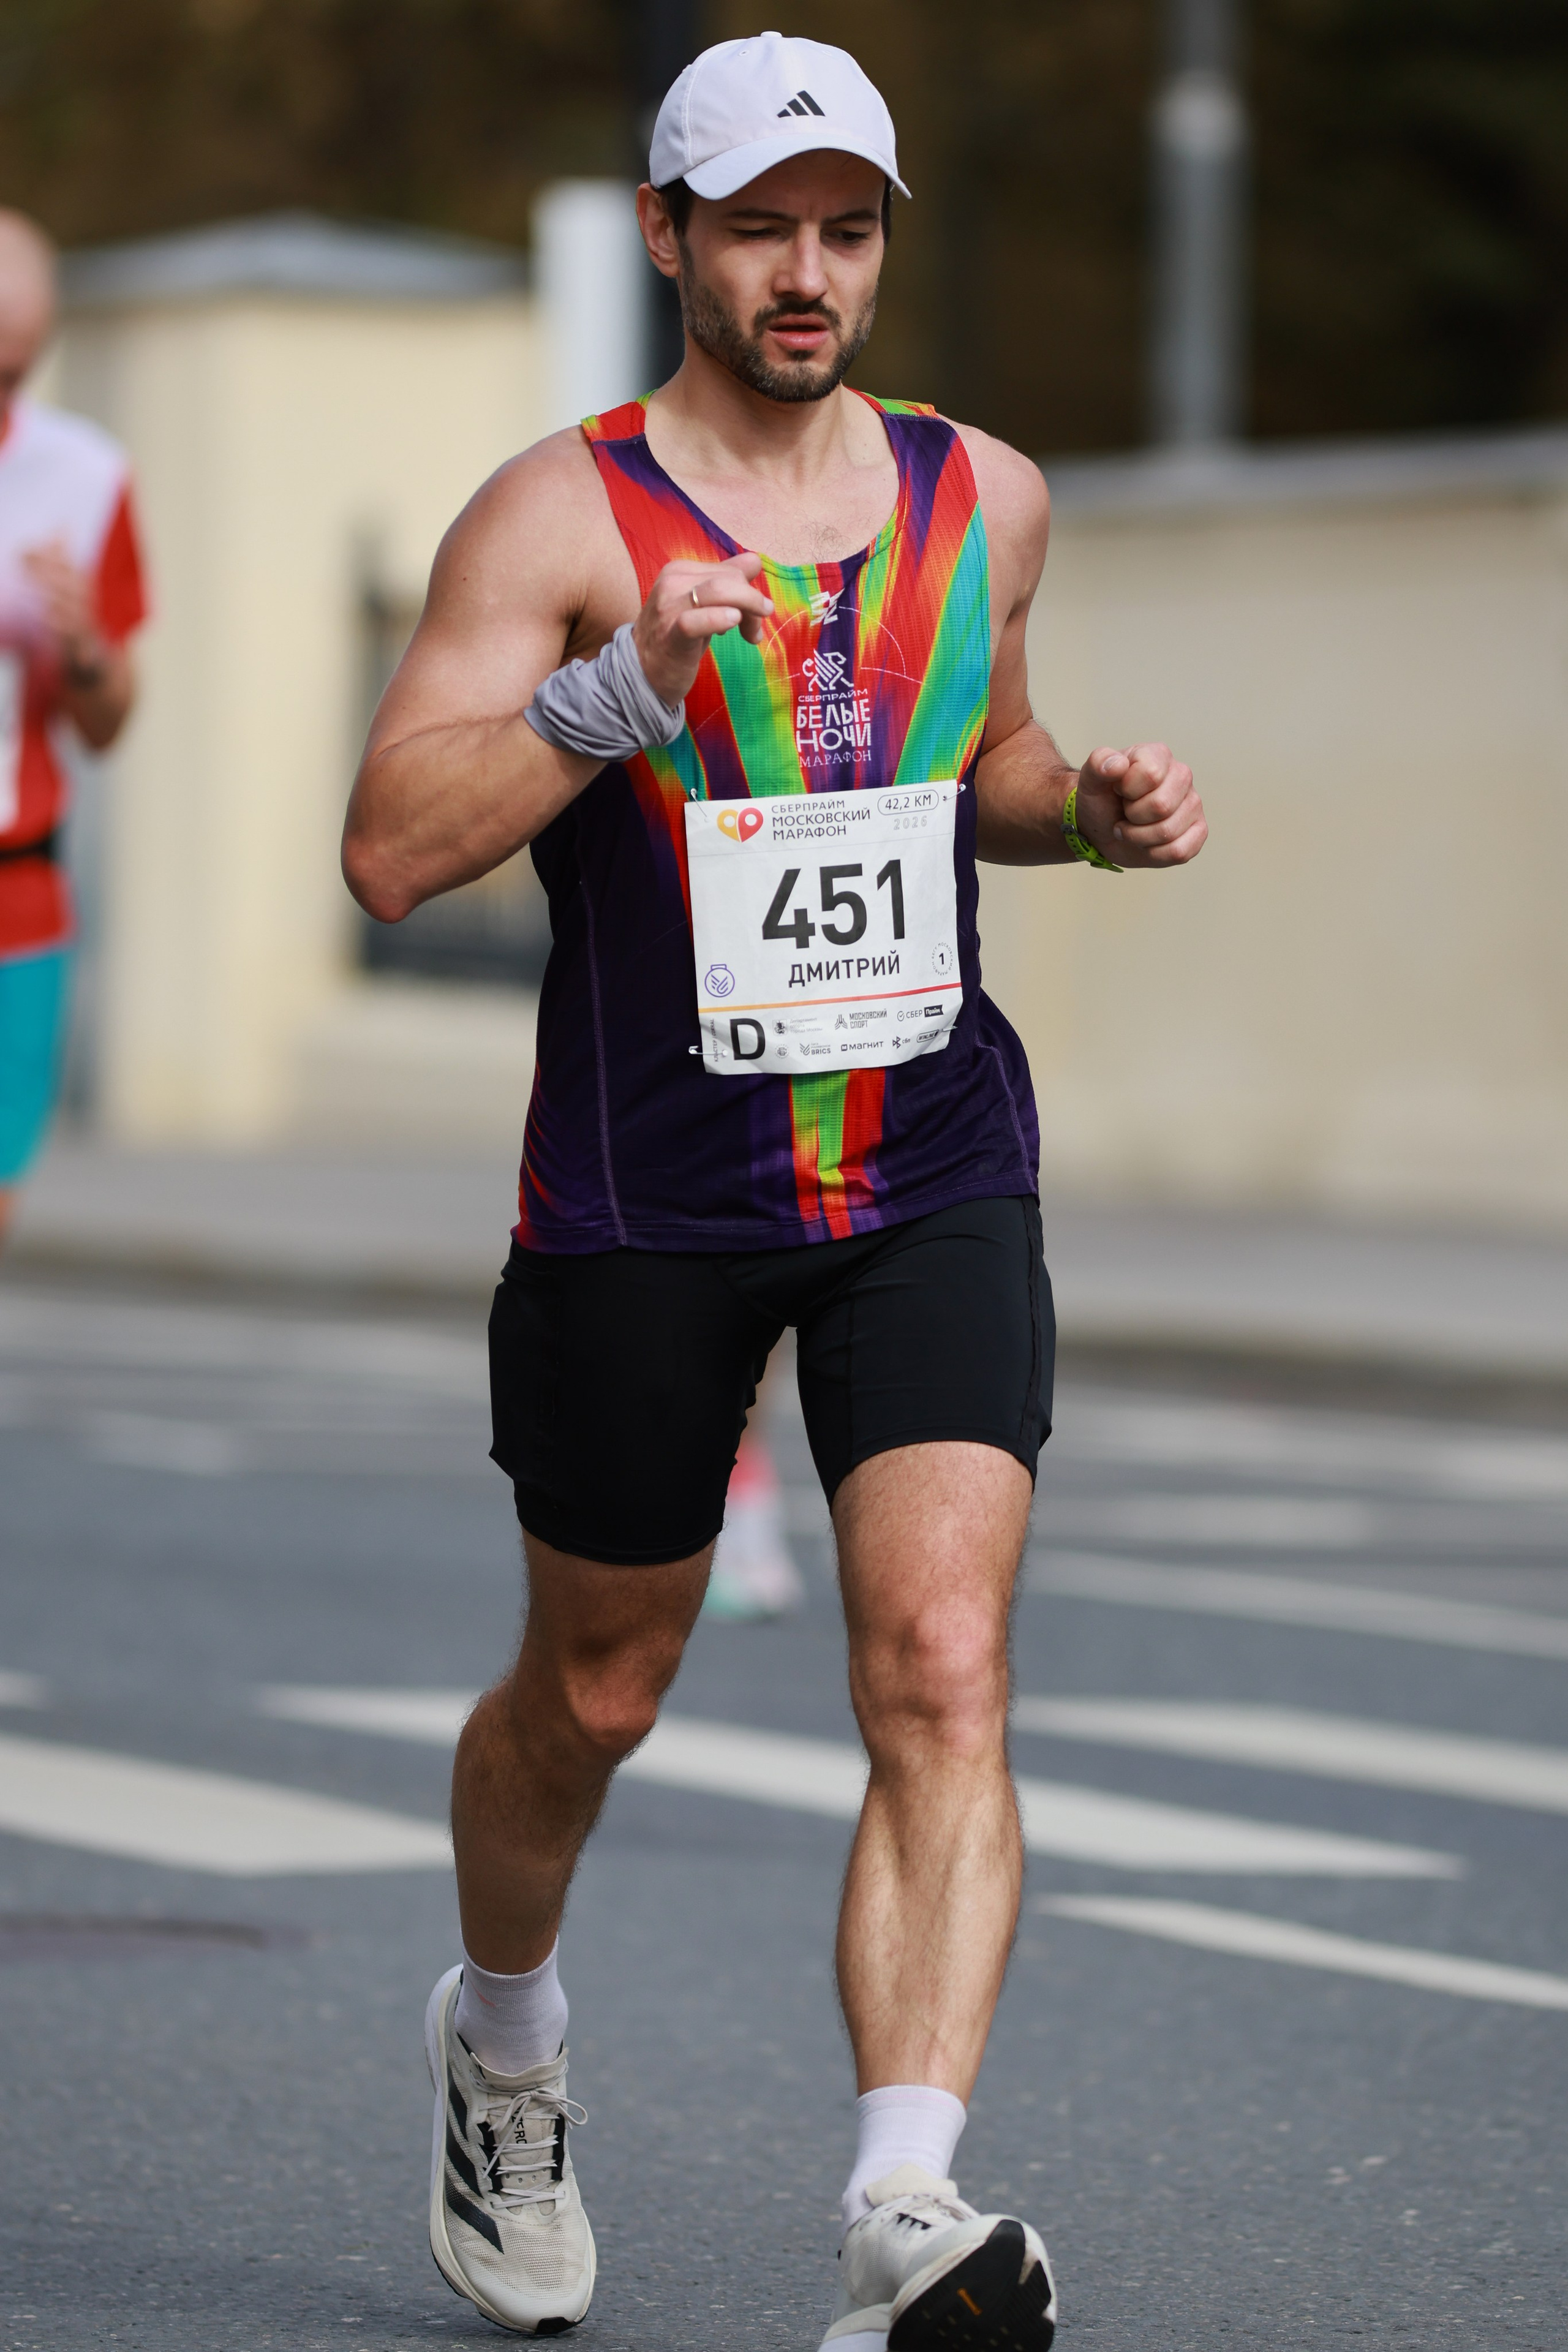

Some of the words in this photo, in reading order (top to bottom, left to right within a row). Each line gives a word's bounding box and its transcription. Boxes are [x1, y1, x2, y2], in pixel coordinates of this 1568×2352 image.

[798, 688, 868, 703] СБЕРПРАЙМ
[796, 698, 871, 729] БЕЛЫЕ
[796, 723, 871, 753] НОЧИ
[799, 750, 871, 768] МАРАФОН
[771, 799, 845, 813] СБЕРПРАЙМ
[885, 797, 910, 810] 42,2
[914, 794, 931, 807] КМ
[772, 807, 870, 827] МОСКОВСКИЙ
[893, 815, 927, 831] 2026
[773, 825, 846, 840] МАРАФОН
[761, 859, 905, 949] 451
[939, 952, 944, 965] 1
[788, 950, 900, 988] ДМИТРИЙ
[849, 1008, 887, 1020] МОСКОВСКИЙ
[906, 1009, 923, 1019] СБЕР
[850, 1020, 868, 1029] СПОРТ
[729, 1018, 766, 1060] D
